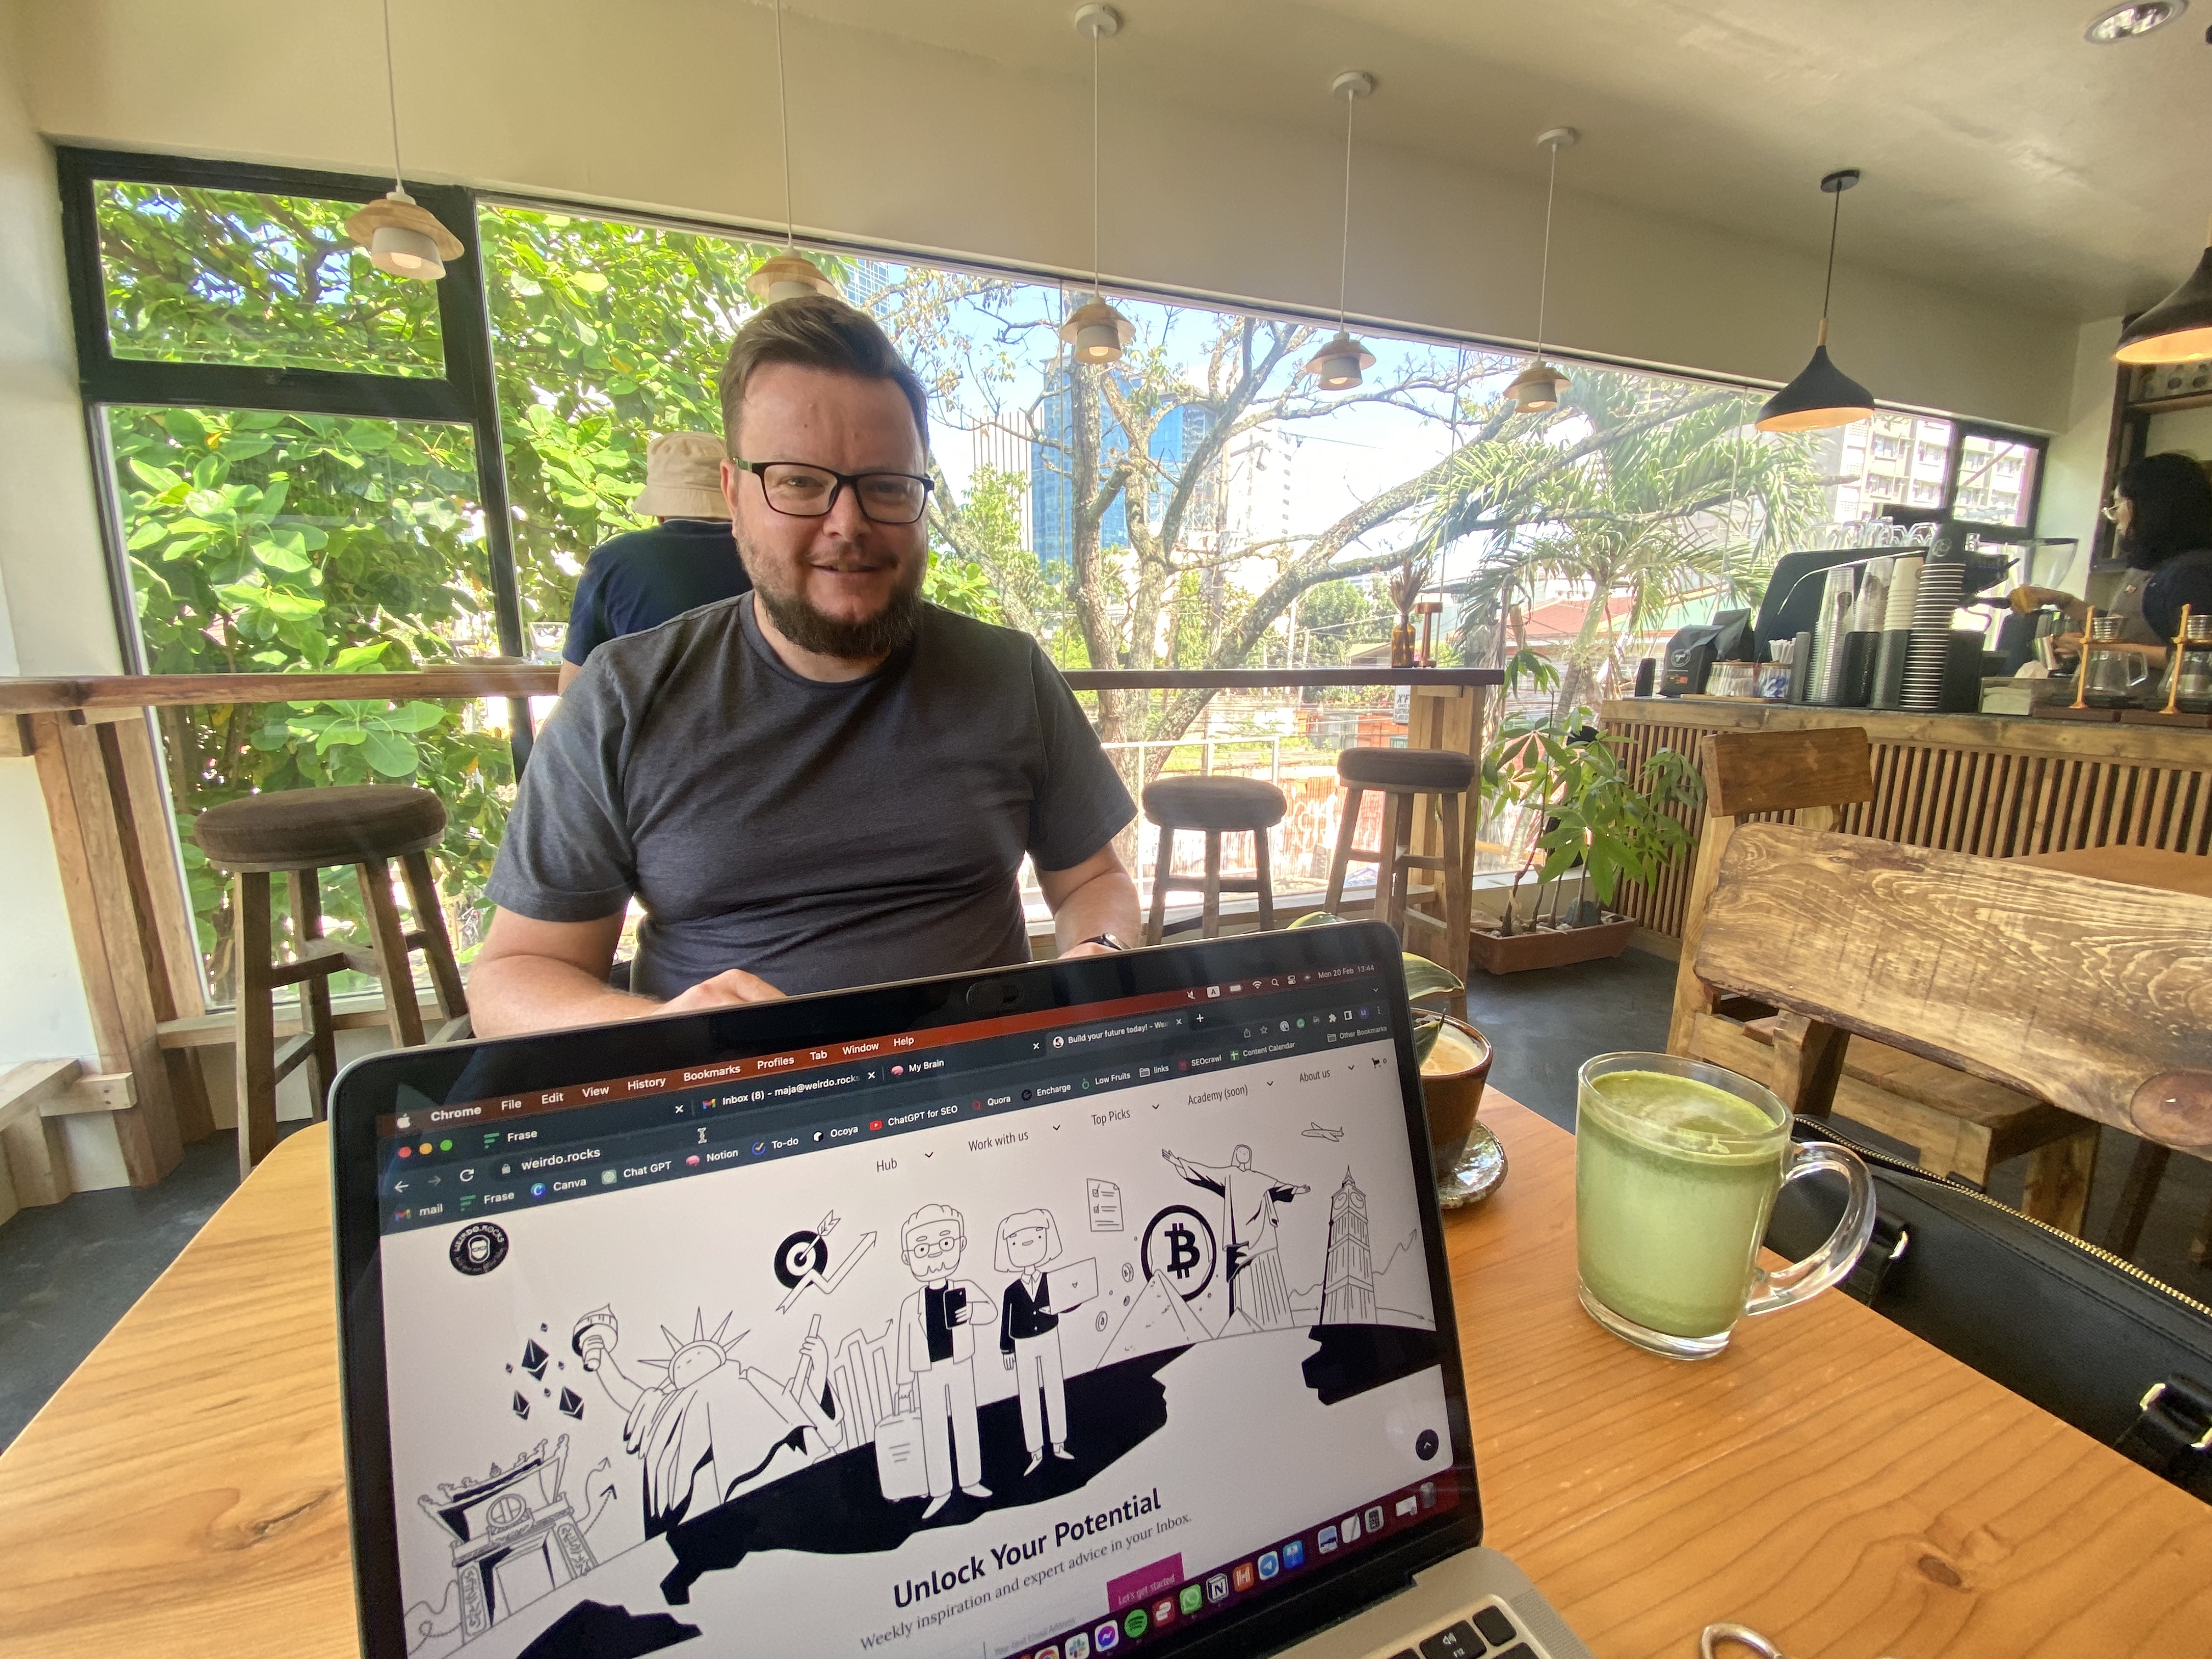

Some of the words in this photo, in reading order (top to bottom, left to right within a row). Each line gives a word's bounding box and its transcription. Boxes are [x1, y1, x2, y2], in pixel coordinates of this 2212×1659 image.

[1318, 970, 1332, 979] Mon
[1357, 965, 1374, 973] 13:44
[1068, 1035, 1086, 1044] Build
[1087, 1031, 1103, 1041] your
[1104, 1028, 1125, 1038] future
[1127, 1024, 1148, 1034] today!
[1339, 1031, 1355, 1039] Other
[1357, 1026, 1387, 1036] Bookmarks
[909, 1064, 922, 1073] My
[923, 1059, 944, 1070] Brain
[431, 1106, 482, 1121] Chrome
[501, 1099, 522, 1111] File
[541, 1092, 563, 1104] Edit
[582, 1086, 610, 1097] View
[628, 1077, 666, 1090] History
[684, 1065, 741, 1082] Bookmarks
[757, 1057, 794, 1069] Profiles
[809, 1051, 827, 1061] Tab
[842, 1043, 879, 1055] Window
[894, 1036, 915, 1047] Help
[723, 1093, 748, 1105] Inbox
[751, 1090, 764, 1102] (8)
[419, 1204, 443, 1216] mail
[484, 1192, 515, 1204] Frase
[553, 1178, 586, 1191] Canva
[623, 1166, 647, 1178] Chat
[650, 1161, 672, 1172] GPT
[706, 1150, 738, 1162] Notion
[771, 1137, 799, 1149] To-do
[830, 1126, 859, 1138] Ocoya
[888, 1111, 925, 1126] ChatGPT
[927, 1109, 938, 1118] for
[941, 1105, 958, 1116] SEO
[988, 1096, 1011, 1107] Quora
[1037, 1084, 1071, 1097] Encharge
[1095, 1076, 1109, 1085] Low
[1111, 1072, 1131, 1082] Fruits
[1153, 1065, 1169, 1073] links
[1191, 1055, 1222, 1066] SEOcrawl
[1243, 1047, 1267, 1057] Content
[1268, 1042, 1295, 1052] Calendar
[877, 1158, 897, 1172] Hub
[968, 1137, 992, 1152] Work
[995, 1133, 1015, 1146] with
[1018, 1132, 1029, 1141] us
[1091, 1114, 1106, 1126] Top
[1109, 1109, 1131, 1122] Picks
[1188, 1090, 1222, 1105] Academy
[1224, 1084, 1248, 1101] (soon)
[1300, 1071, 1320, 1082] About
[507, 1130, 537, 1142] Frase
[521, 1147, 601, 1171] weirdo.rocks
[894, 1555, 985, 1608] Unlock
[990, 1534, 1047, 1570] Your
[1054, 1487, 1162, 1548] Potential
[860, 1622, 912, 1651] Weekly
[917, 1592, 991, 1629] inspiration
[995, 1578, 1019, 1599] and
[1024, 1562, 1065, 1587] expert
[1069, 1546, 1108, 1570] advice
[1111, 1539, 1122, 1552] in
[1126, 1527, 1153, 1550] your
[1157, 1514, 1193, 1534] Inbox.
[1453, 1647, 1465, 1658] F12
